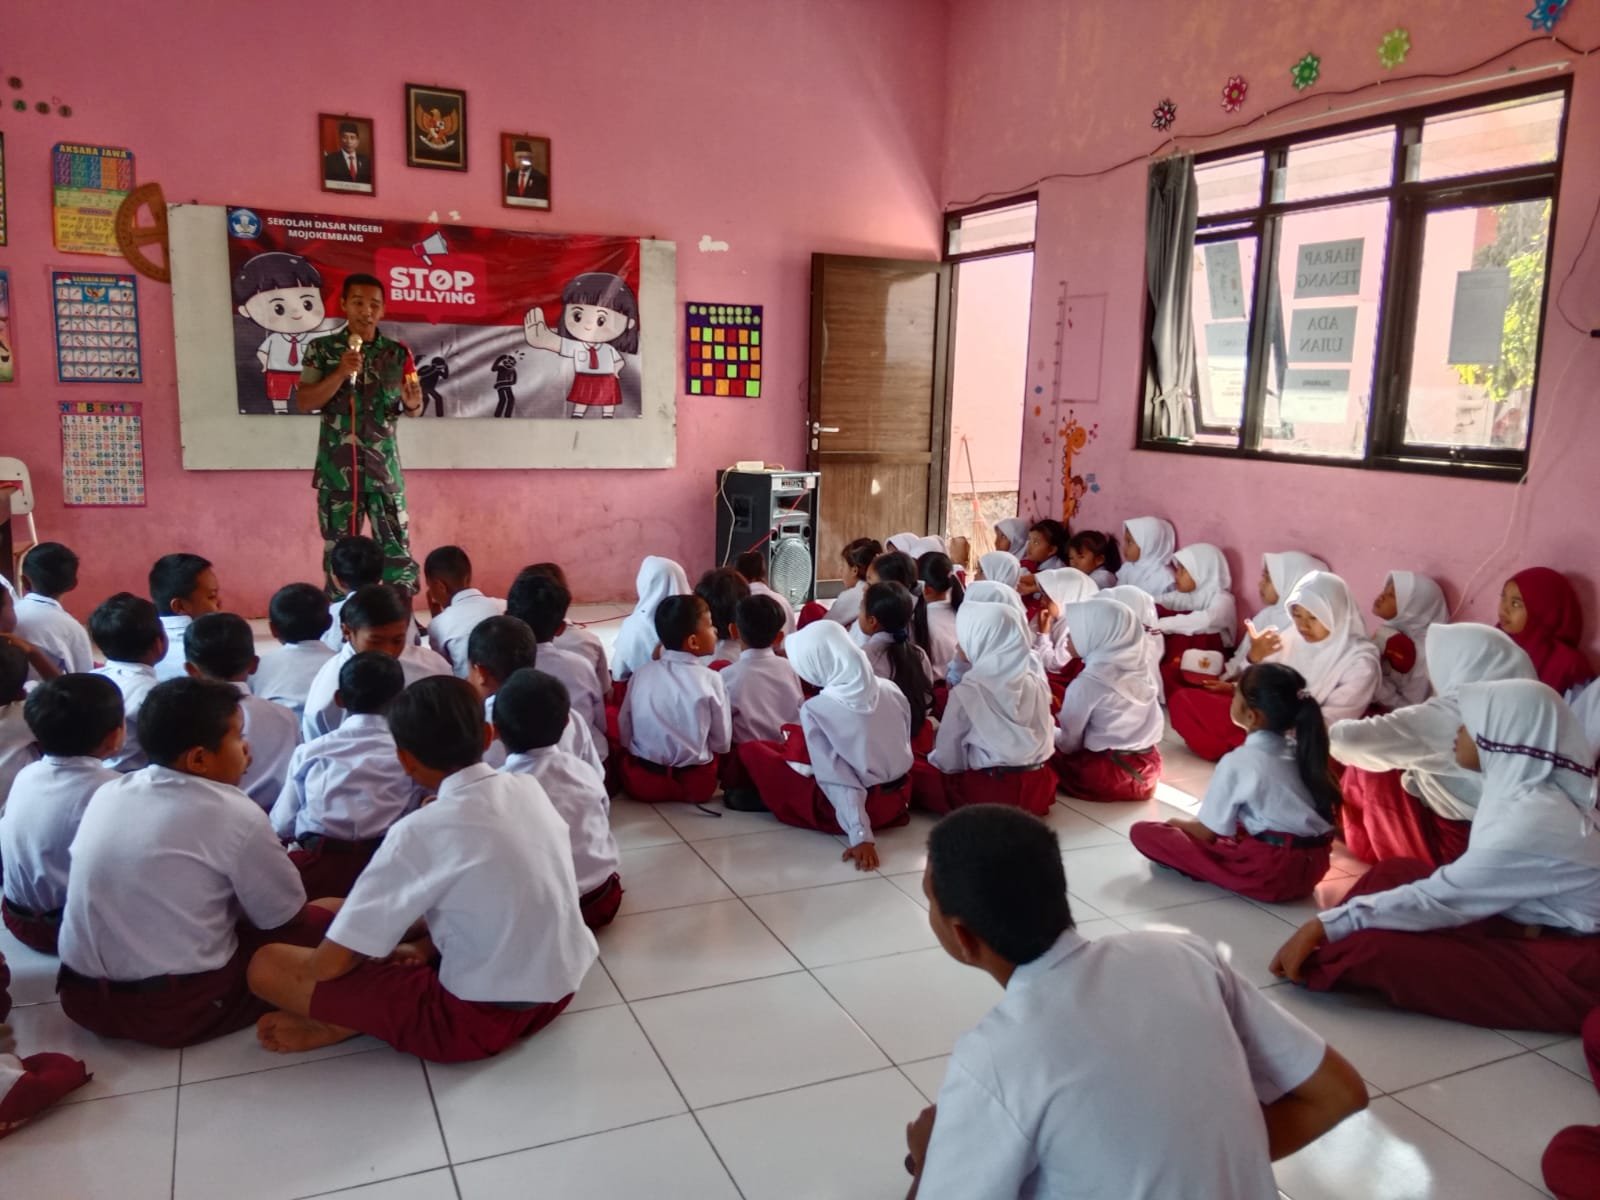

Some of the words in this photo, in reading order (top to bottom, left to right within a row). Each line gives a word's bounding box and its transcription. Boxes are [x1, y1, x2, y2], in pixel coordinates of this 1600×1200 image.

[59, 144, 99, 156] AKSARA
[101, 148, 128, 159] JAWA
[267, 217, 312, 228] SEKOLAH
[314, 221, 347, 231] DASAR
[348, 223, 383, 233] NEGERI
[288, 229, 364, 242] MOJOKEMBANG
[390, 266, 475, 292] STOP
[391, 288, 476, 305] BULLYING
